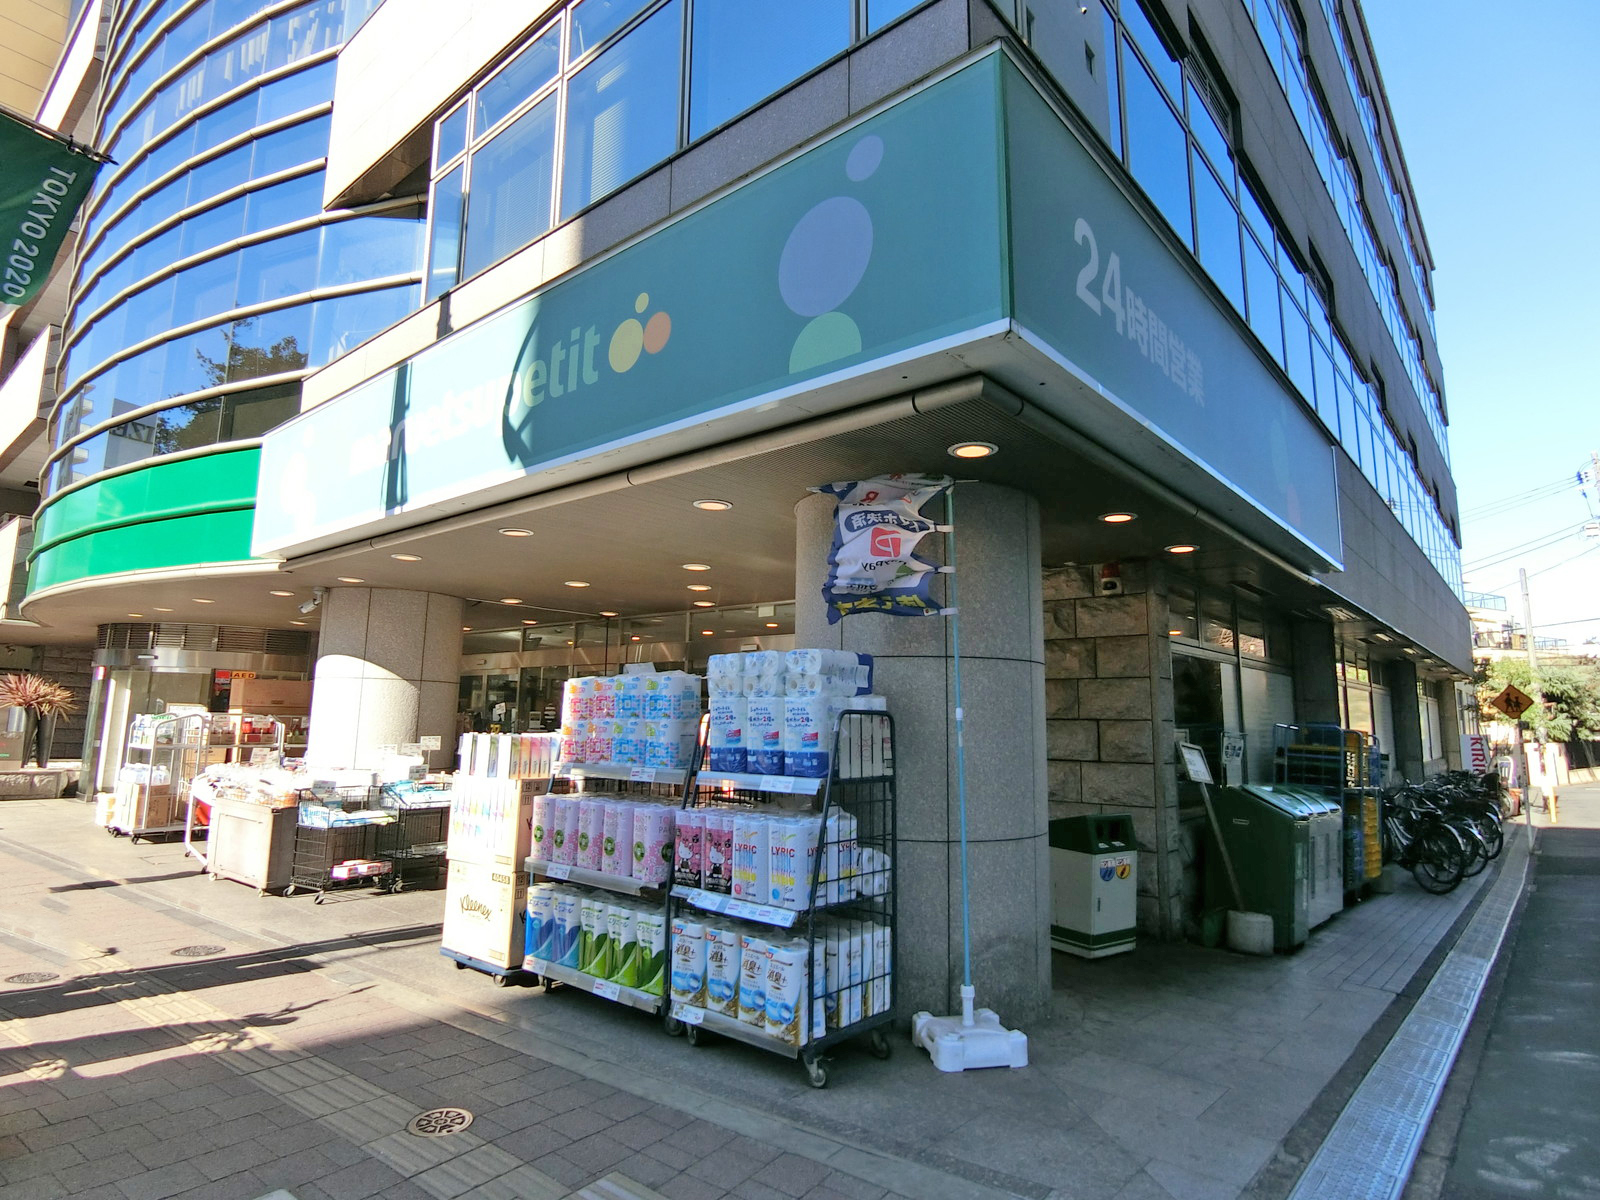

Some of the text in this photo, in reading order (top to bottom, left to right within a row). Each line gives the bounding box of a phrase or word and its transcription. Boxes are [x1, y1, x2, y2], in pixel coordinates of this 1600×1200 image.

[3, 166, 78, 298] TOKYO 2020
[735, 842, 757, 855] LYRIC
[771, 845, 796, 858] LYRIC
[459, 893, 492, 922] Kleenex
